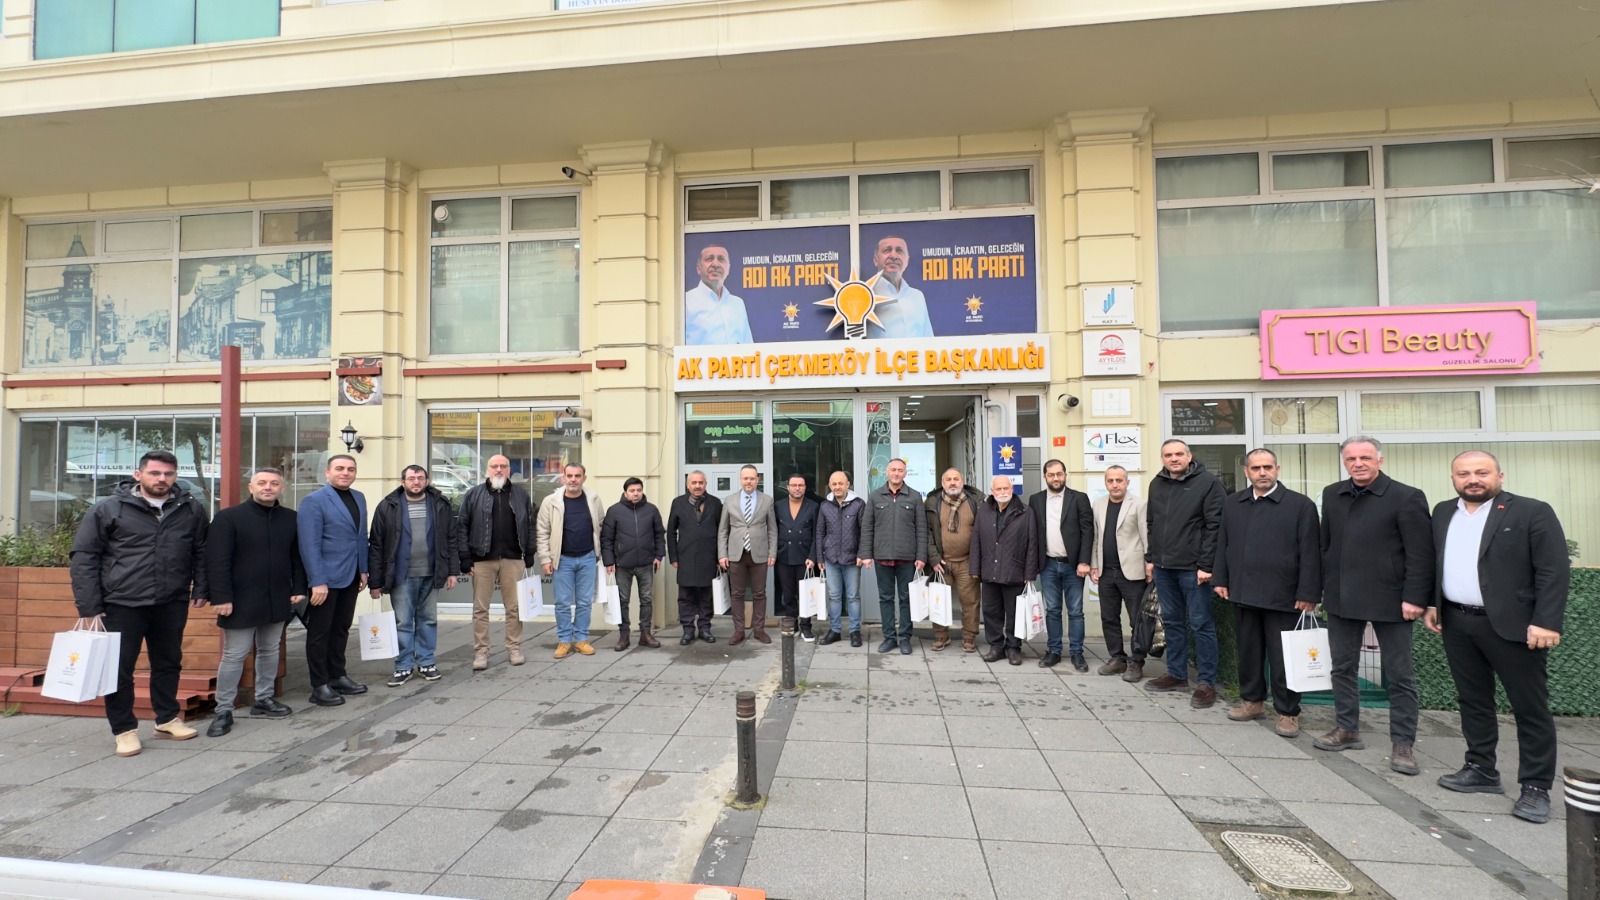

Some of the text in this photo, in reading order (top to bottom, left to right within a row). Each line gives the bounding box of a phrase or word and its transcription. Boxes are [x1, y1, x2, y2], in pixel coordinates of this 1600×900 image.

[742, 250, 839, 265] UMUDUN, İCRAATIN, GELECEĞİN
[922, 242, 1025, 257] UMUDUN, İCRAATIN, GELECEĞİN
[922, 254, 1025, 280] ADI AK PARTİ
[742, 266, 767, 289] ADI
[770, 265, 792, 288] AK
[1304, 327, 1495, 358] TIGI Beauty
[677, 341, 1045, 384] AK PARTİ ÇEKMEKÖY İLÇE BAŞKANLIĞI
[1442, 358, 1481, 366] GÜZELLİK
[1105, 432, 1138, 444] Flex
